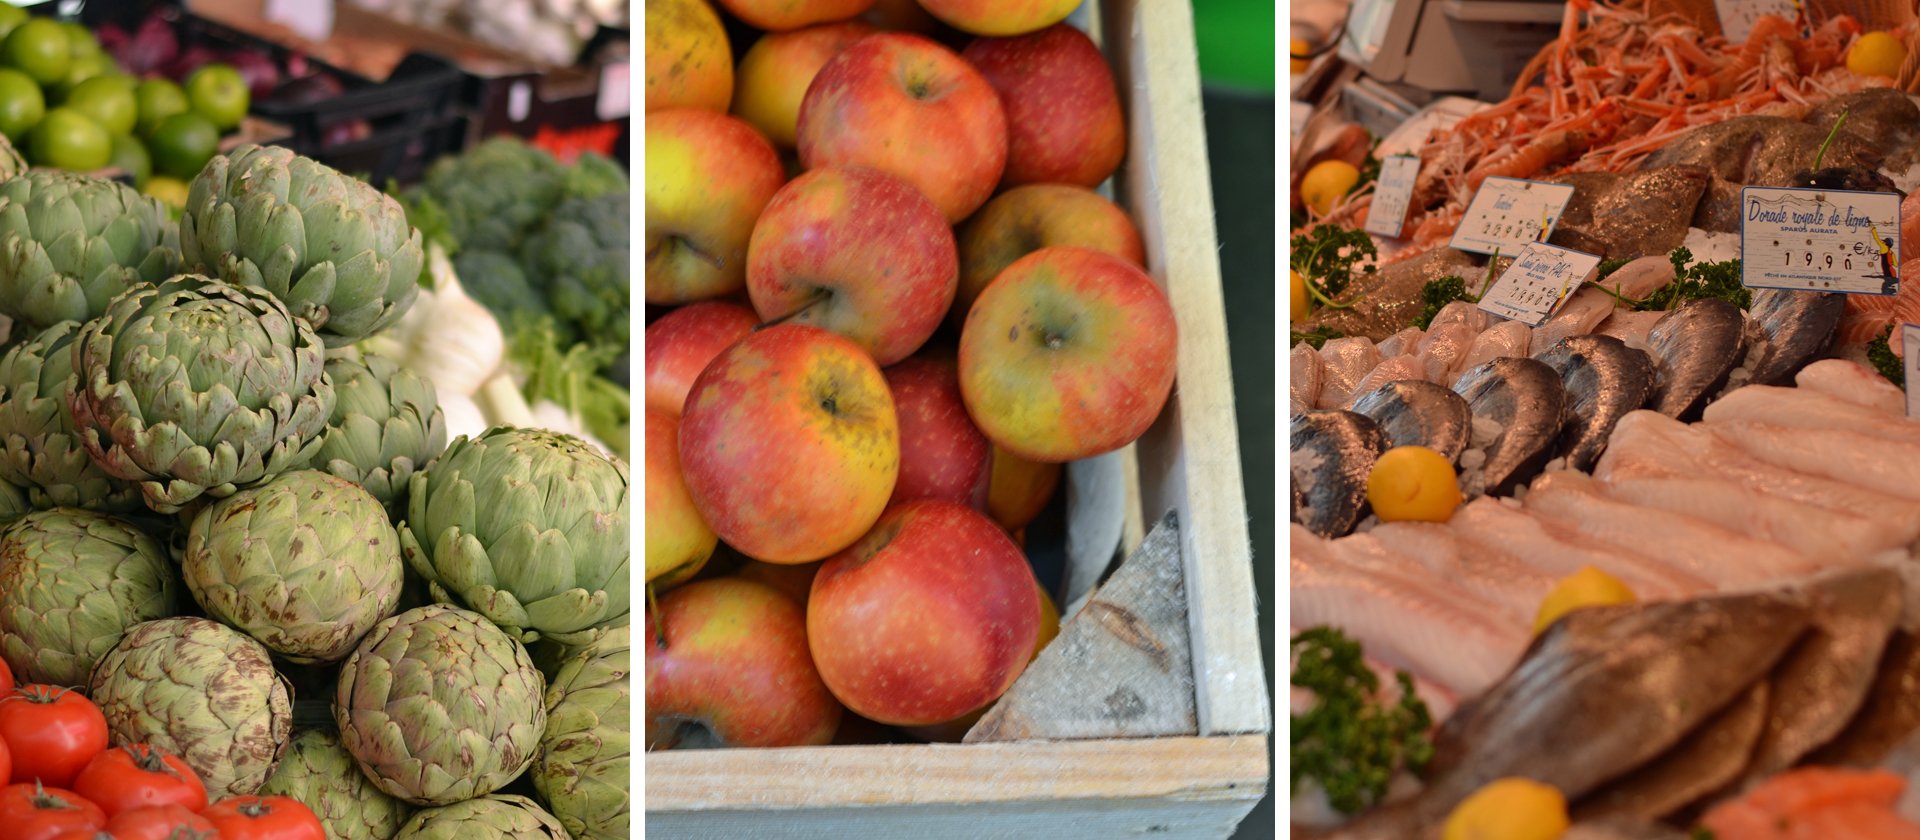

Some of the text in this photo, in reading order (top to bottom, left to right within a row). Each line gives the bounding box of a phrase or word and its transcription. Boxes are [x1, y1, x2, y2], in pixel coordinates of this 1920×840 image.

[1748, 200, 1870, 234] Dorade royale de ligne
[1780, 226, 1807, 234] SPARUS
[1853, 242, 1881, 261] €/kg
